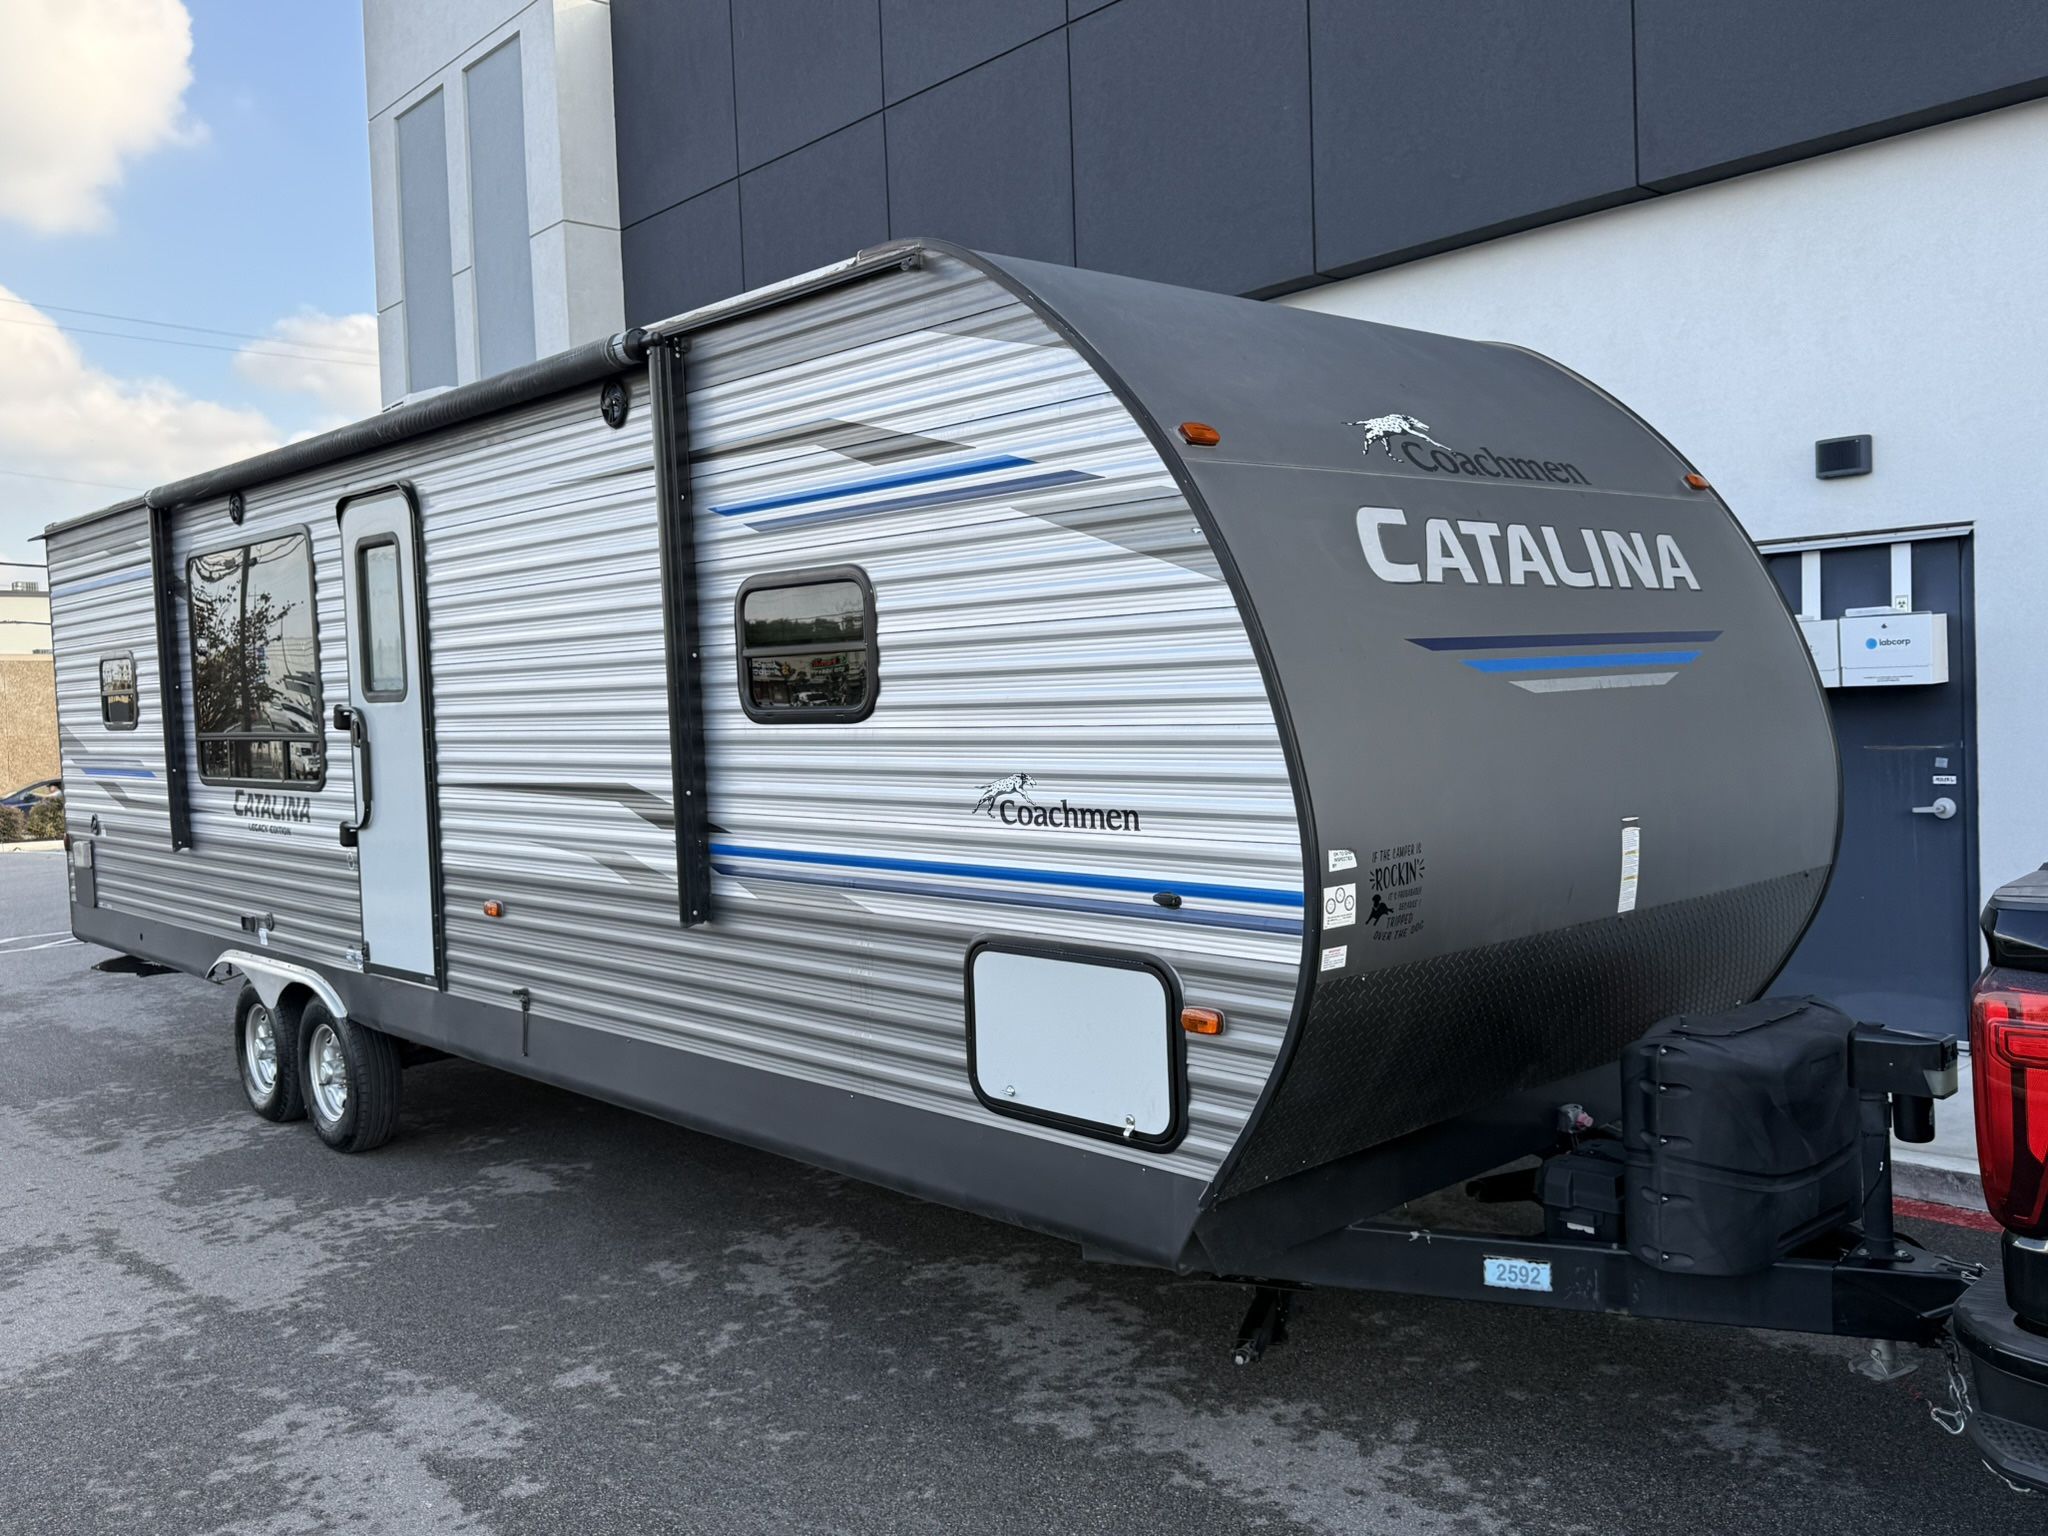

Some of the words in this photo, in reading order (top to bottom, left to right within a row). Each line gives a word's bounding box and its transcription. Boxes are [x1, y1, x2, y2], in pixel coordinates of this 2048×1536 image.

[1401, 441, 1592, 485] Coachmen
[1355, 506, 1702, 591] CATALINA
[1879, 638, 1911, 647] labcorp
[233, 789, 311, 823] CATALINA
[1000, 799, 1140, 832] Coachmen
[248, 823, 269, 833] LEGACY
[269, 825, 292, 836] EDITION
[1380, 849, 1391, 862] THE
[1392, 843, 1415, 860] CAMPER
[1373, 930, 1393, 941] OVER
[1496, 1263, 1541, 1285] 2592
